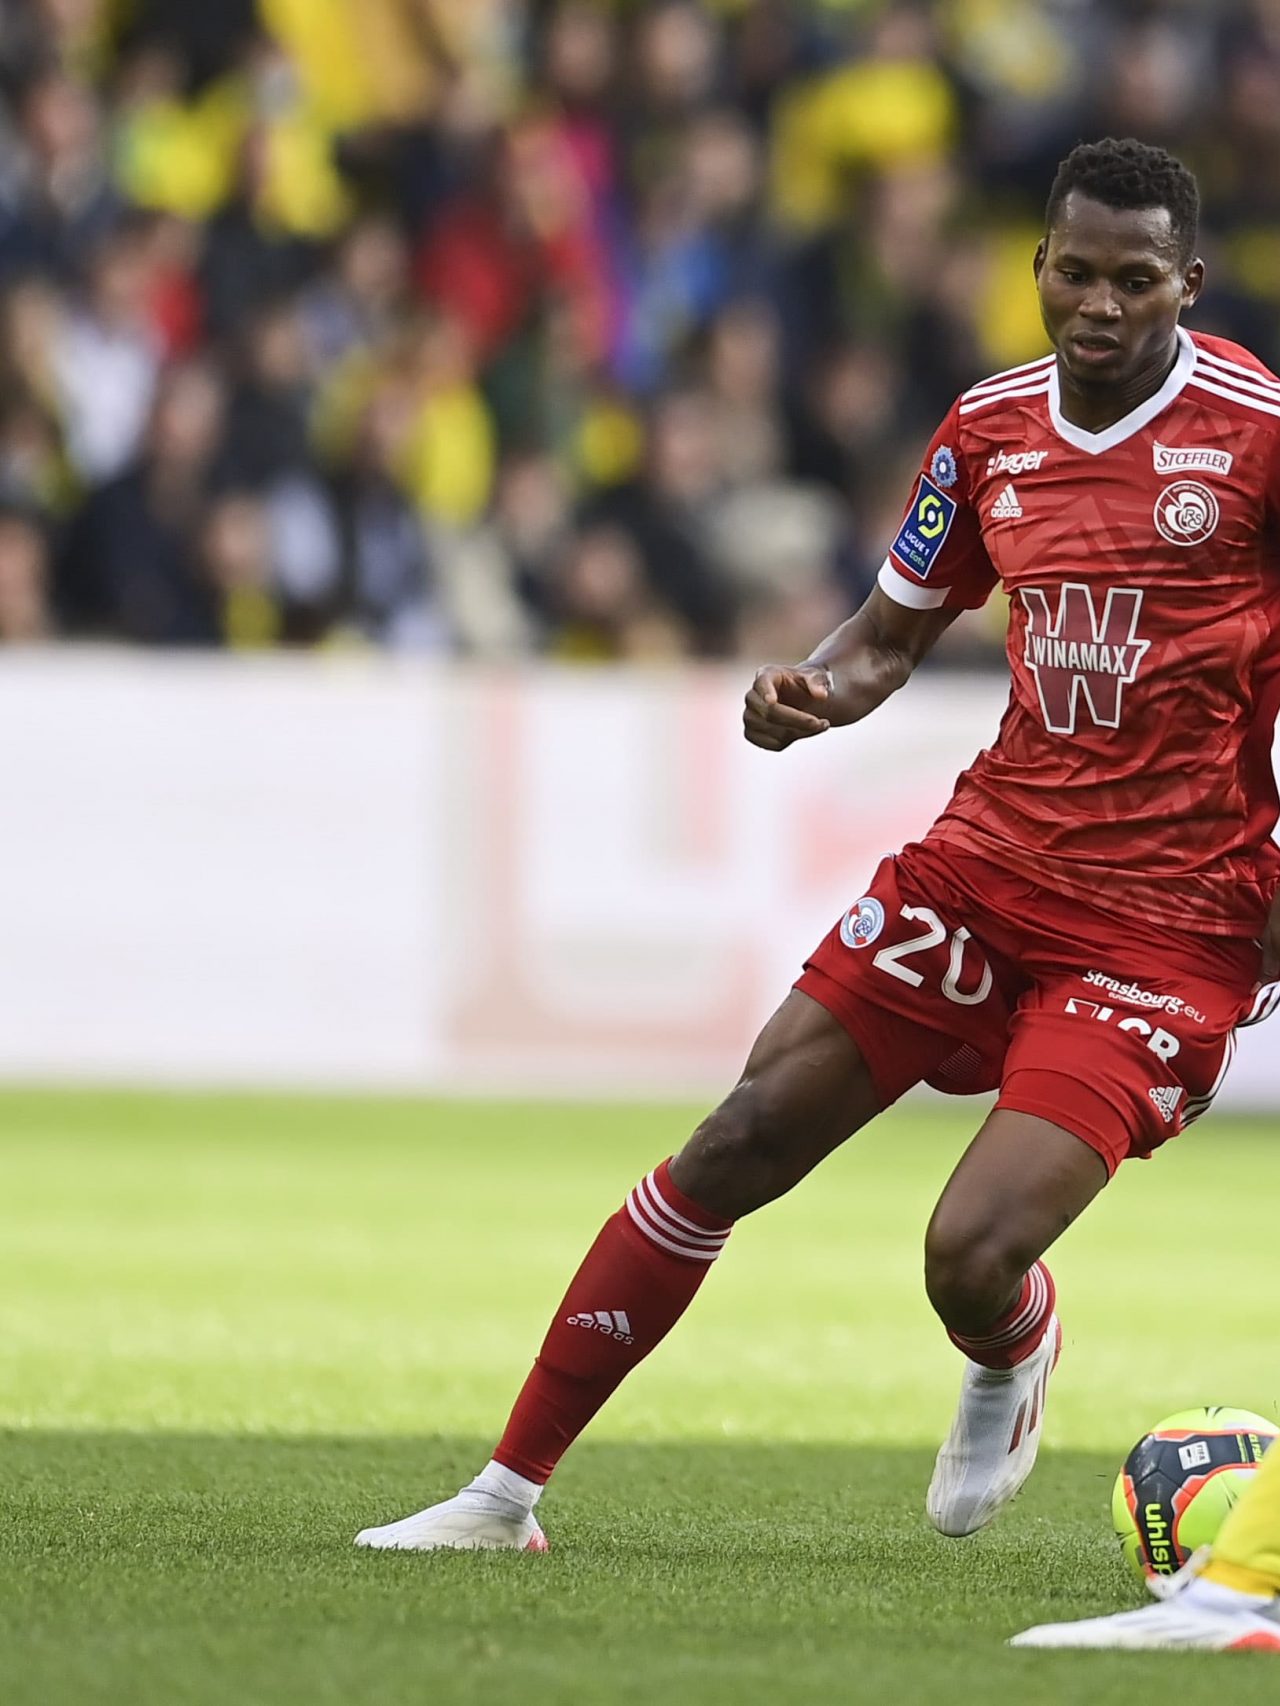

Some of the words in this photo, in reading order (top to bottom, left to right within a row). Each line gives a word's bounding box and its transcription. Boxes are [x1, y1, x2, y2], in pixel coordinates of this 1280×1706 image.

[991, 506, 1023, 518] adidas
[897, 537, 911, 555] Uber
[908, 550, 926, 568] Eats
[904, 529, 926, 553] LIGUE
[1031, 634, 1128, 676] WINAMAX
[872, 904, 993, 1006] 20
[566, 1316, 634, 1345] adidas
